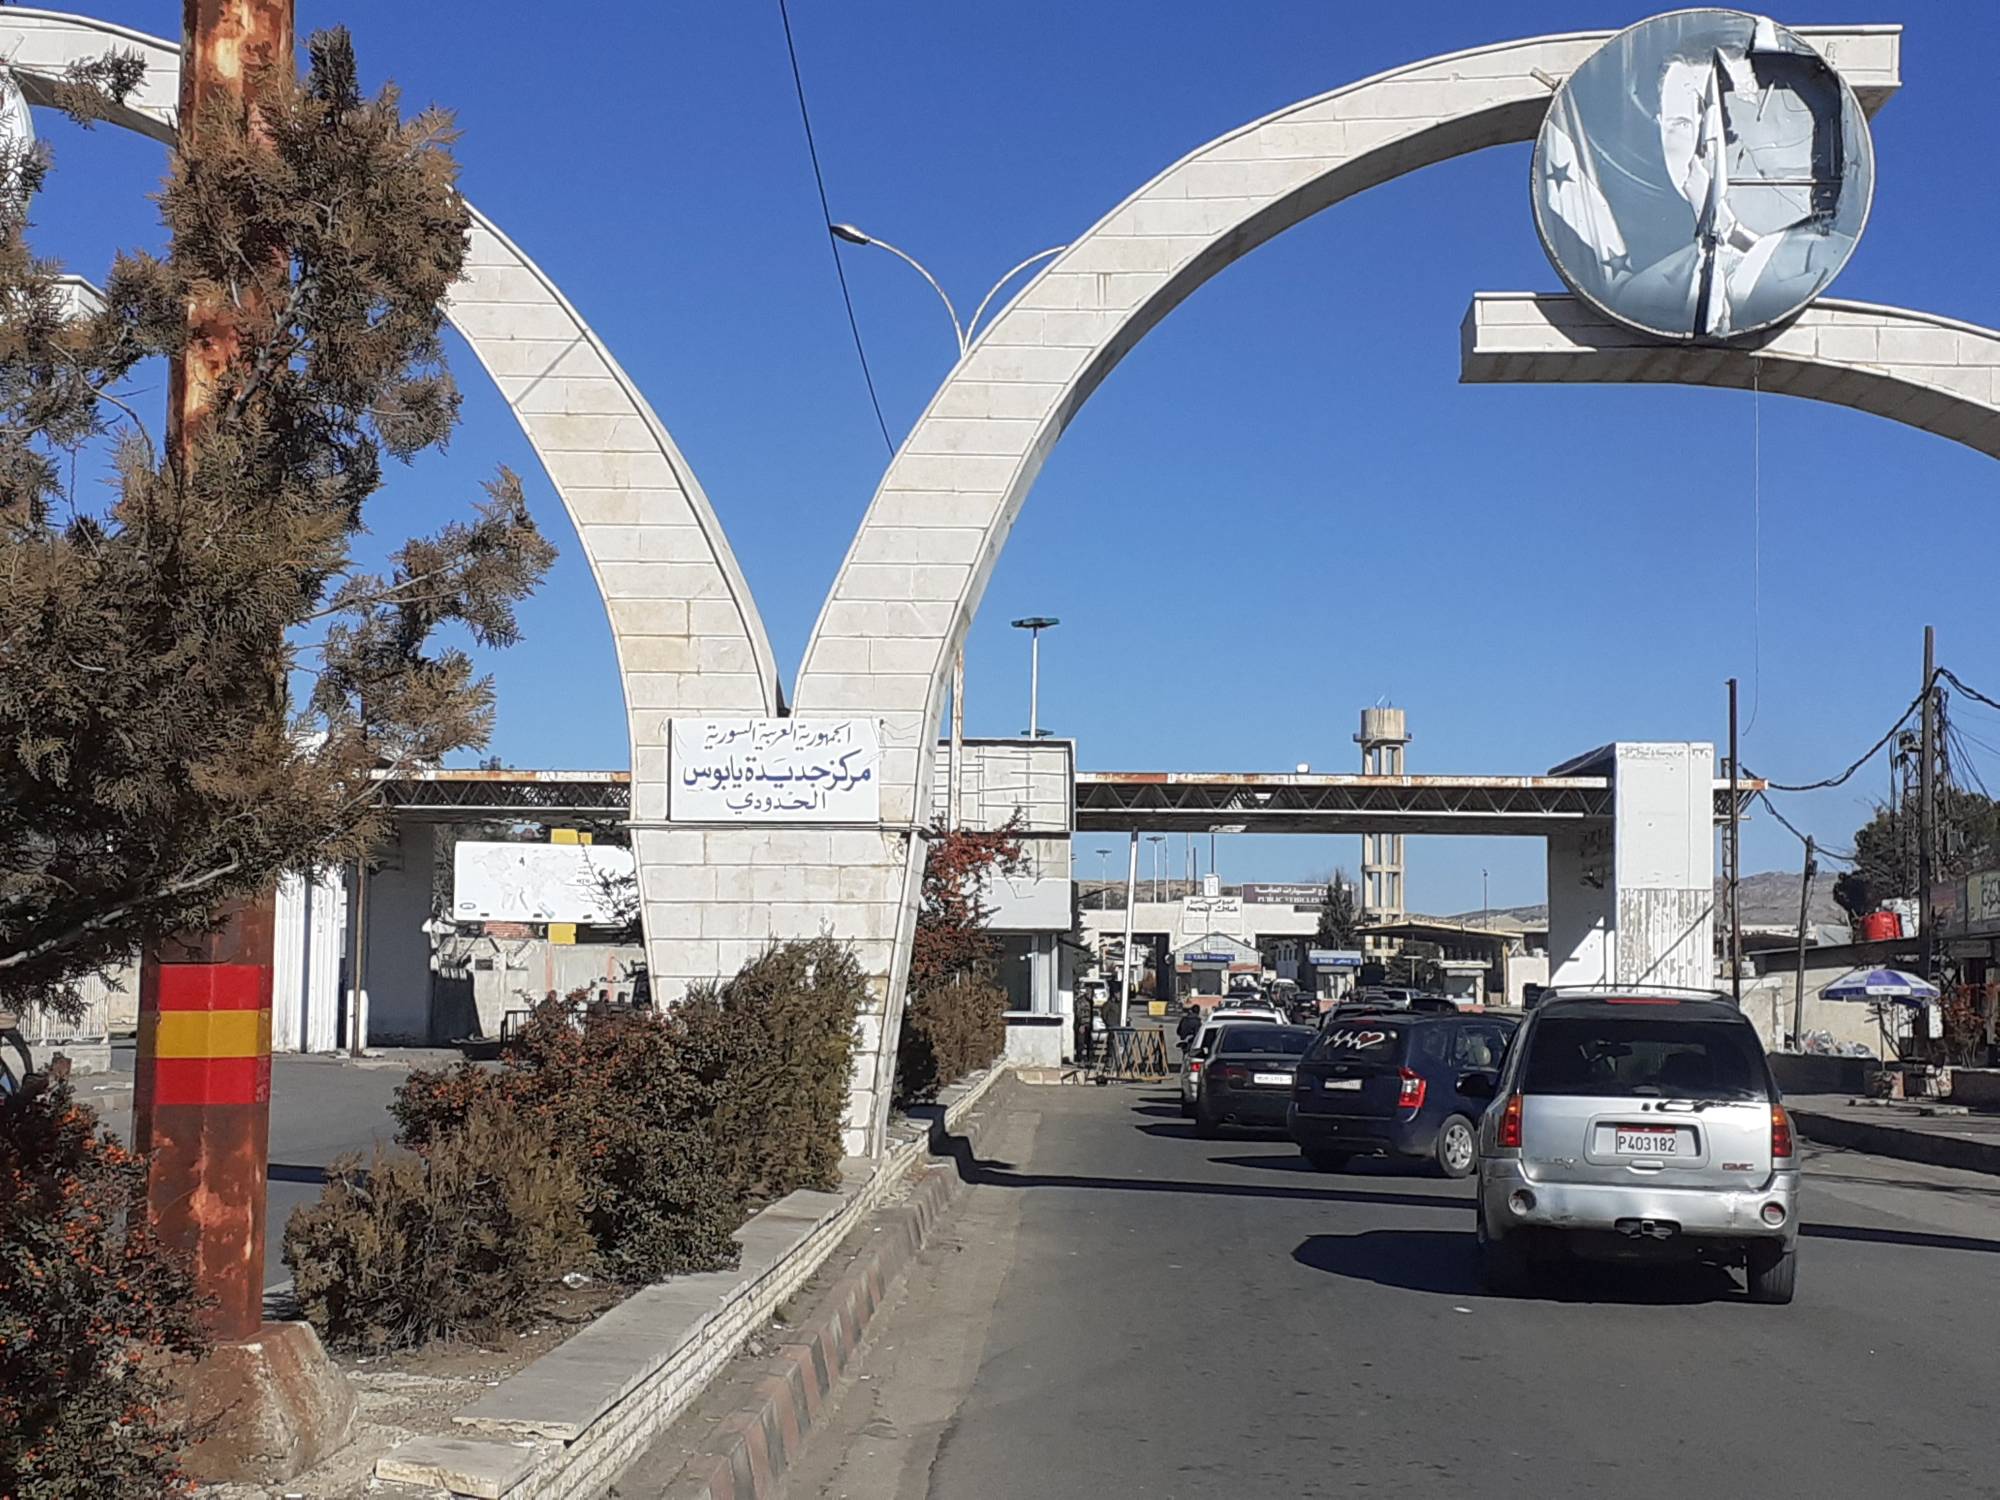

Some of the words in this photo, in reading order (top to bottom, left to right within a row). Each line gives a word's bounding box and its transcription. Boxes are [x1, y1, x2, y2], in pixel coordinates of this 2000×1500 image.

[704, 720, 756, 749] السورية
[755, 720, 797, 750] العربية
[795, 721, 852, 751] الجمهورية
[683, 754, 743, 791] يابوس
[823, 748, 872, 791] مركز
[726, 790, 826, 815] الحدودي
[1619, 1135, 1676, 1152] P403182
[1722, 1162, 1754, 1171] GMC
